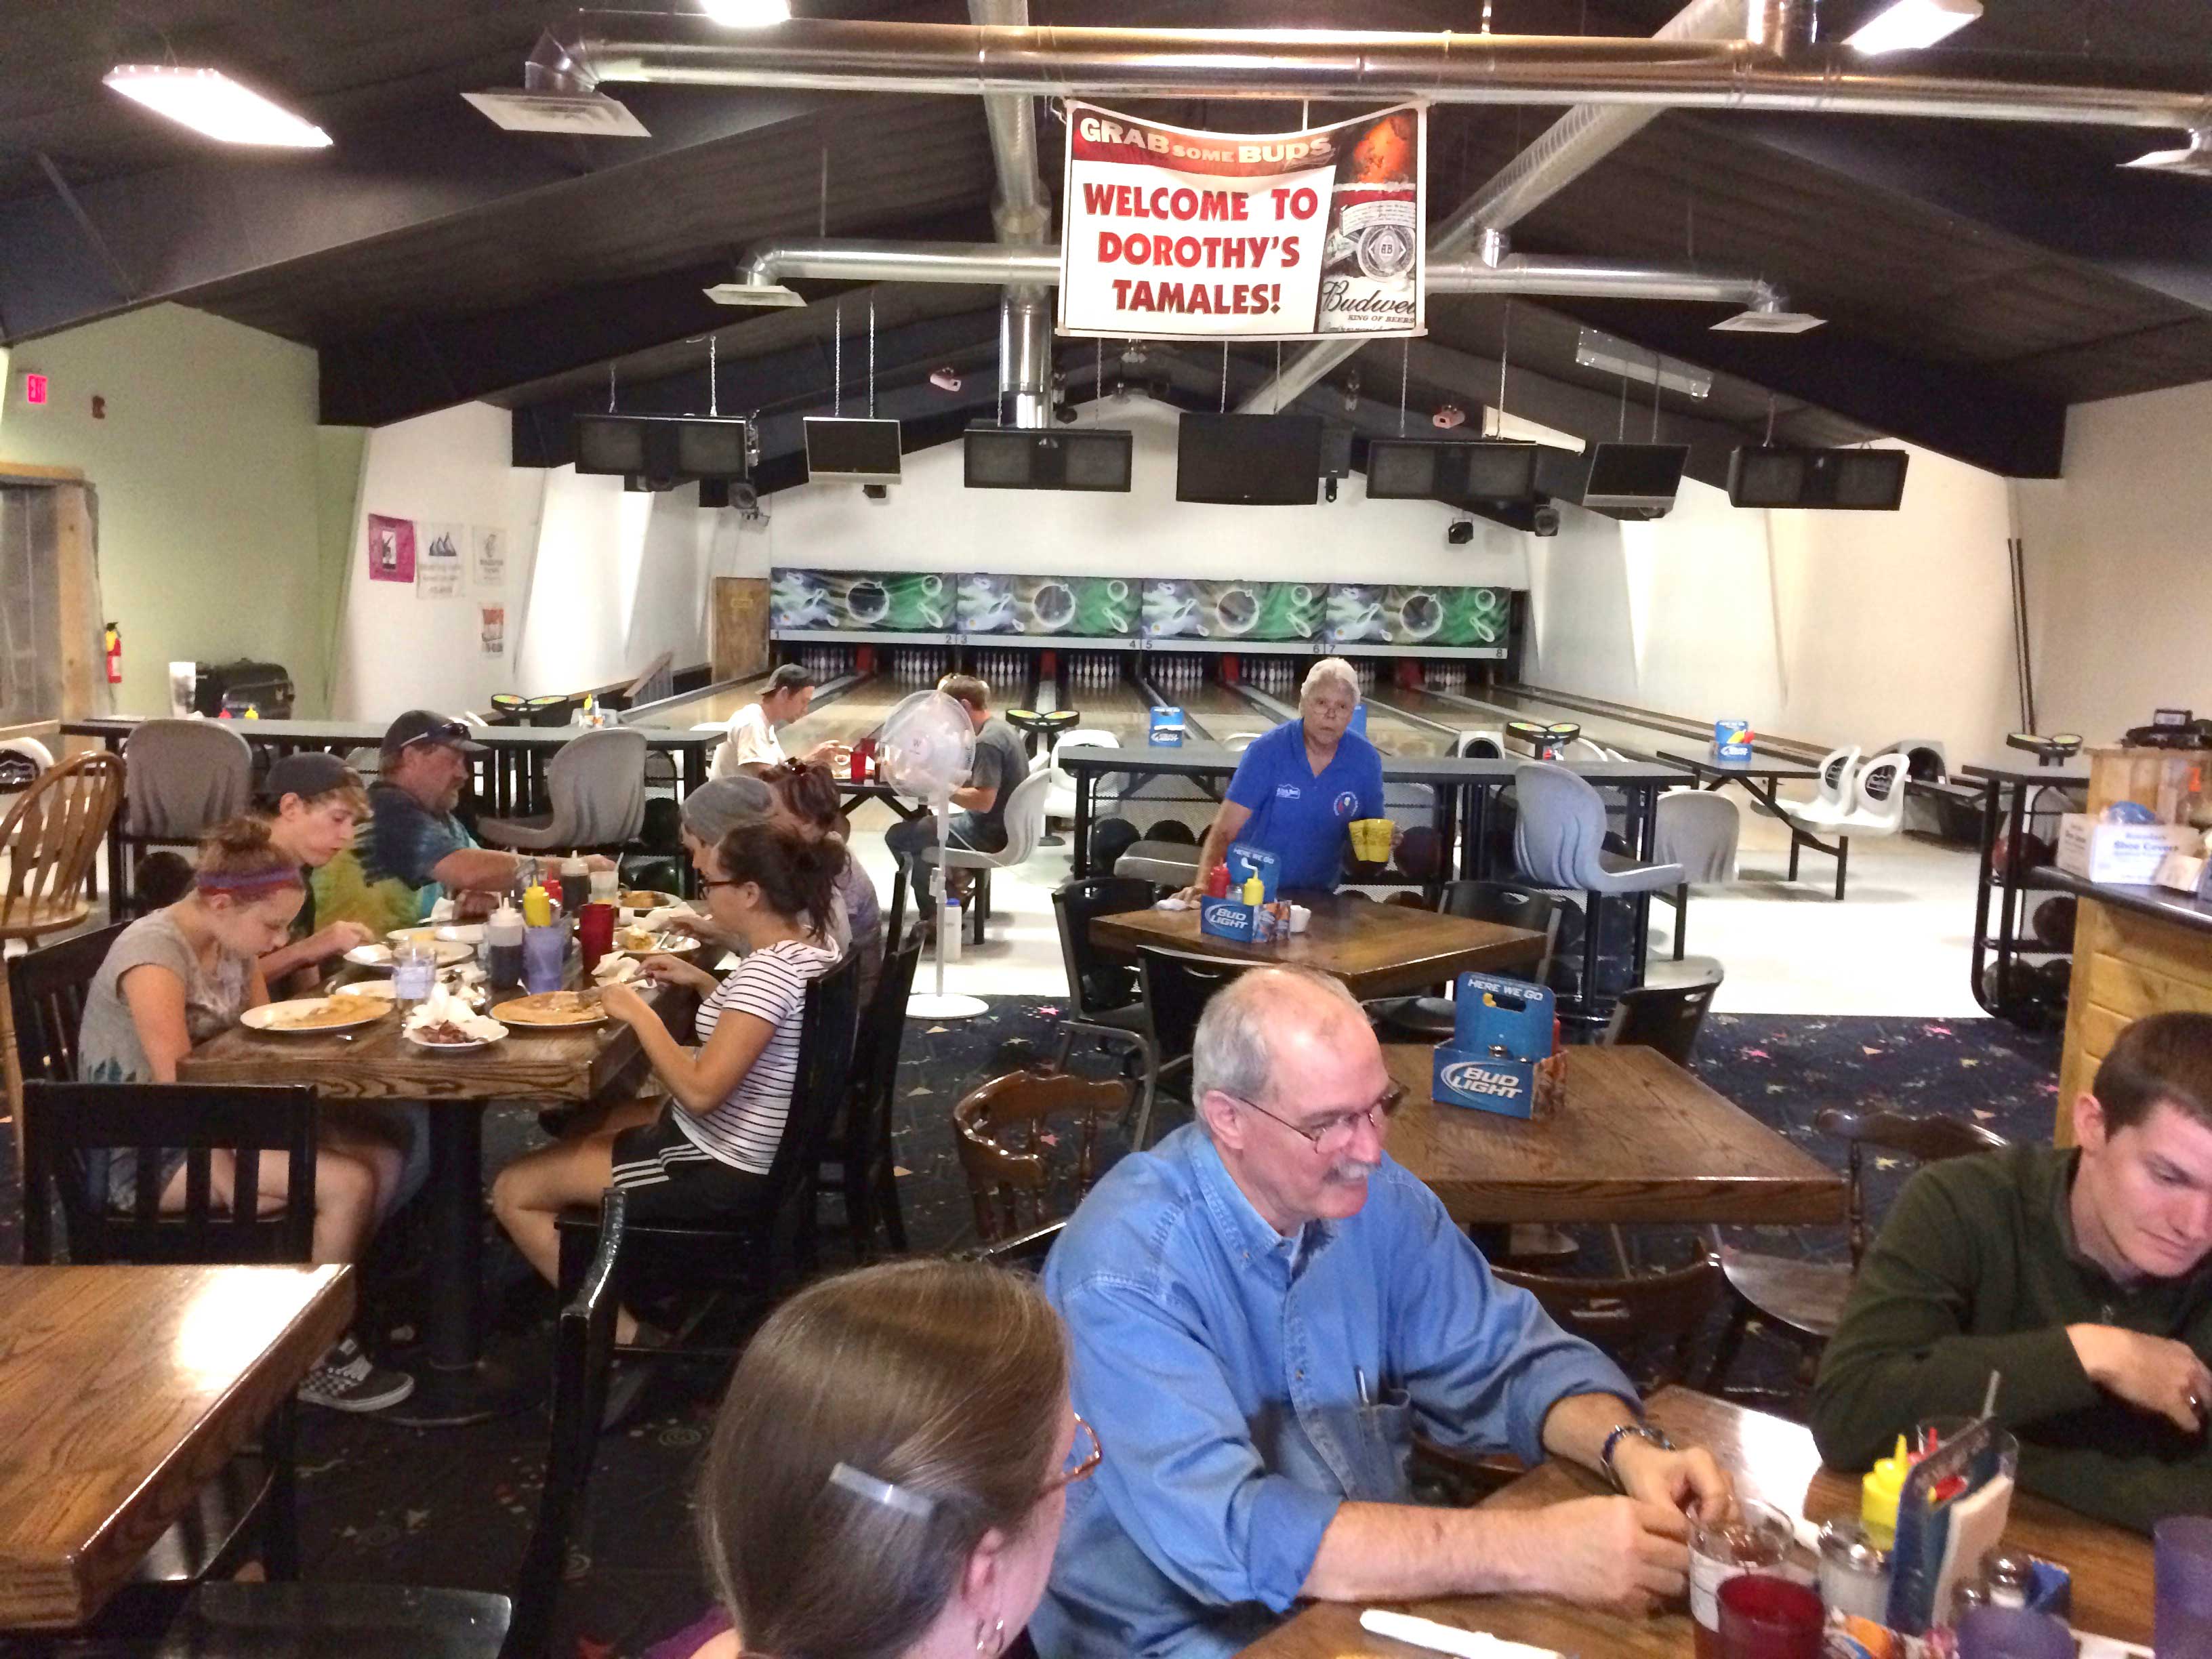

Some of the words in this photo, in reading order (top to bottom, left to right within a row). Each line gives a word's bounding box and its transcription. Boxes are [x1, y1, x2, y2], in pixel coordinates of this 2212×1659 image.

[1080, 117, 1170, 154] GRAB
[1172, 144, 1235, 163] SOME
[1238, 138, 1332, 163] BUDS
[1083, 183, 1249, 221] WELCOME
[1271, 188, 1318, 220] TO
[1098, 232, 1300, 269] DOROTHY'S
[1111, 279, 1282, 314] TAMALES!
[1210, 915, 1248, 929] LIGHT
[1216, 908, 1247, 920] BUD
[1468, 979, 1501, 992] HERE
[1504, 985, 1523, 997] WE
[1523, 989, 1543, 1001] GO
[1452, 1076, 1523, 1099] LIGHT
[1462, 1067, 1519, 1087] BUD
